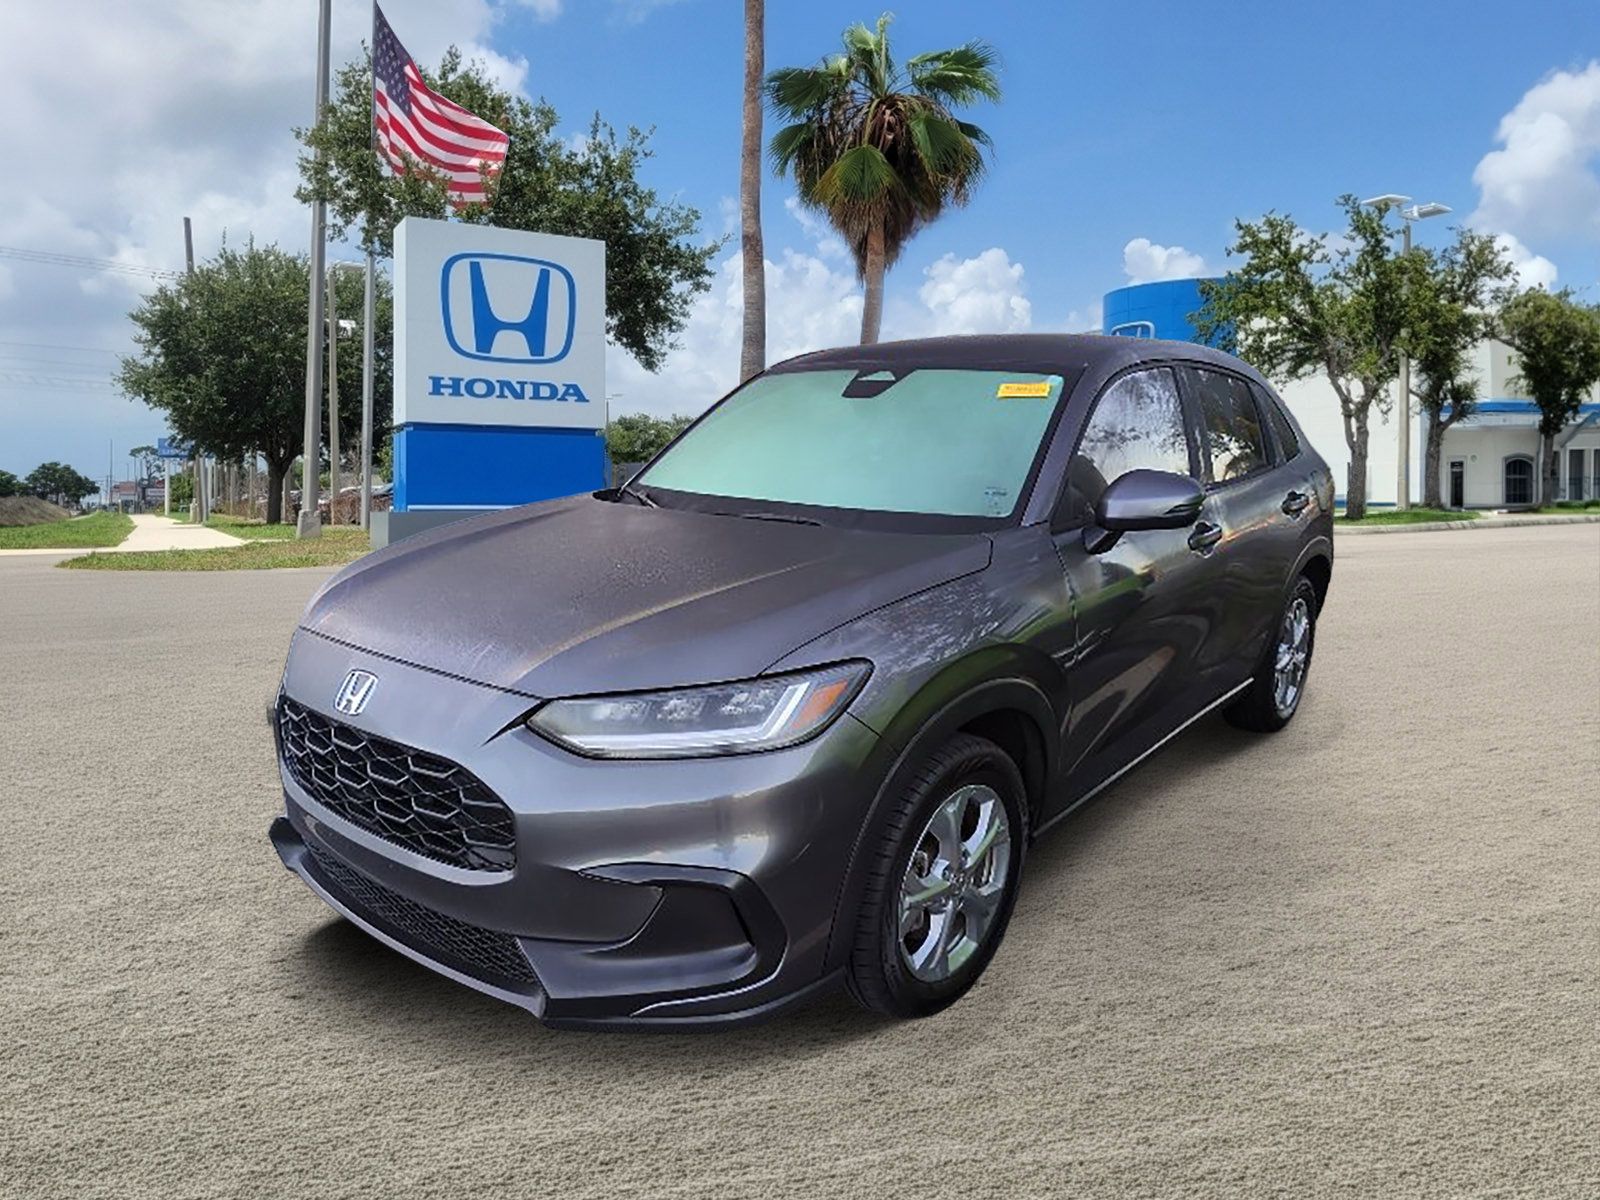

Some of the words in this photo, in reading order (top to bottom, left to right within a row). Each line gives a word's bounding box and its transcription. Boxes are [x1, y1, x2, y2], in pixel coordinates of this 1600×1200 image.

[468, 259, 552, 358] H
[428, 375, 590, 403] HONDA
[336, 669, 377, 714] H
